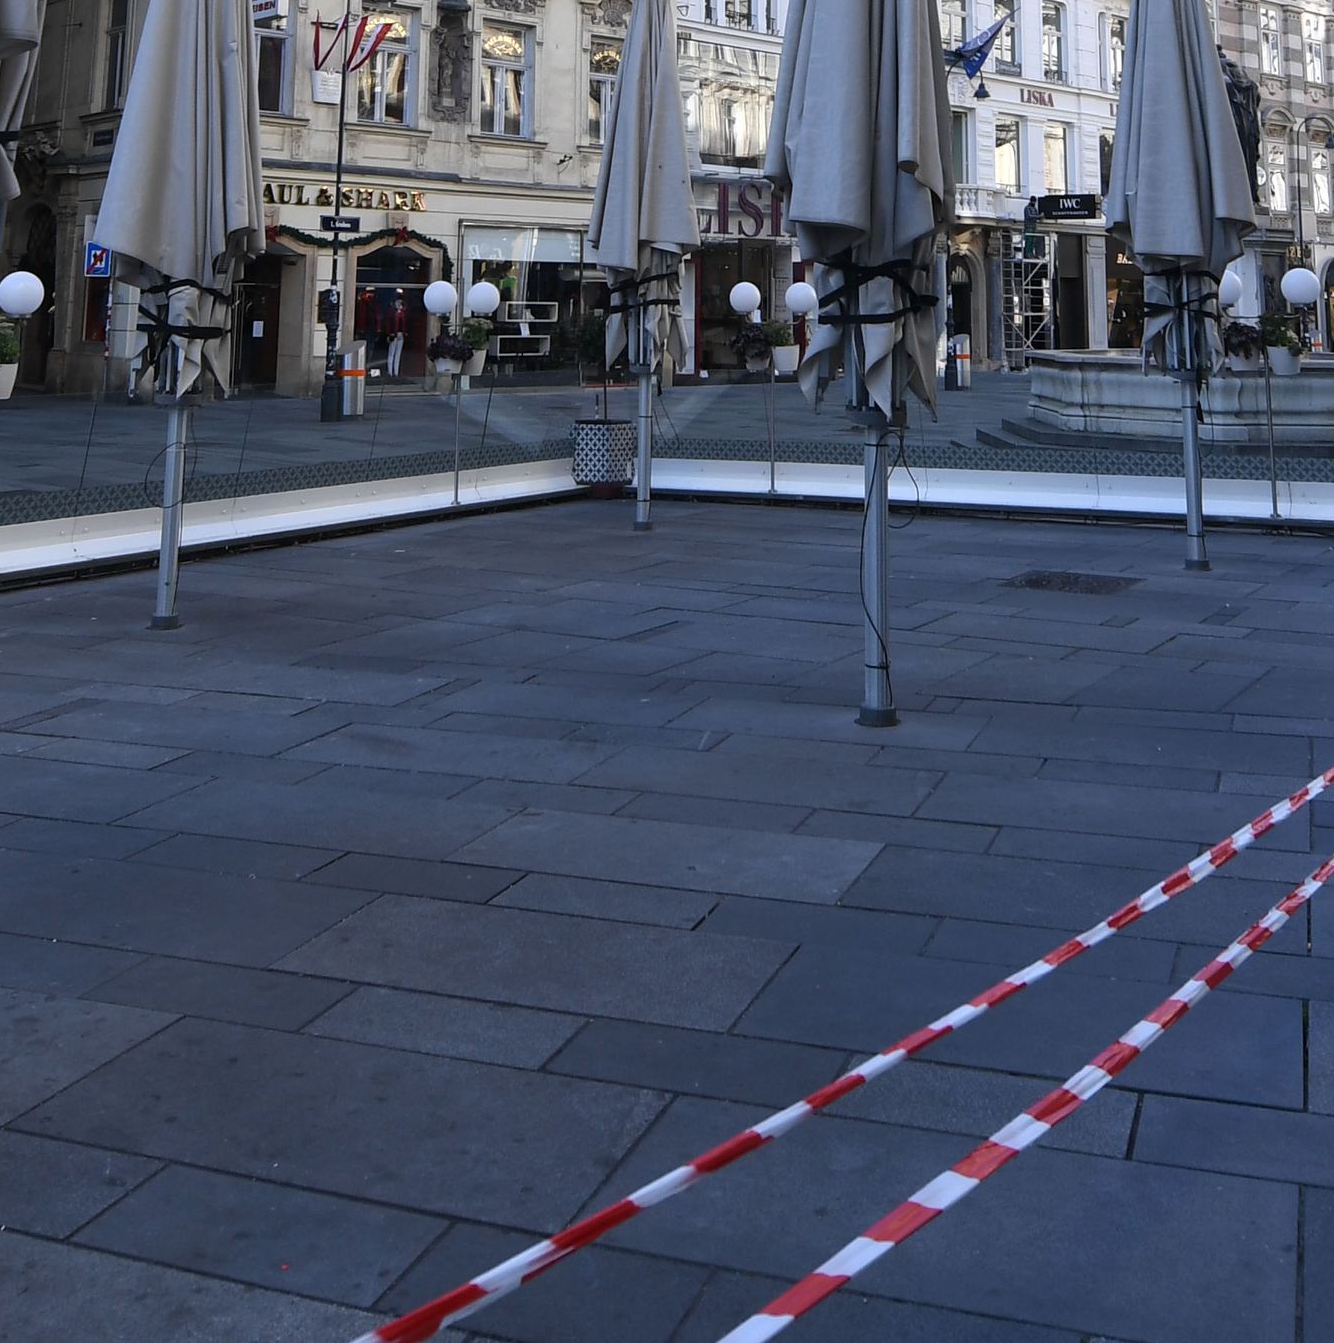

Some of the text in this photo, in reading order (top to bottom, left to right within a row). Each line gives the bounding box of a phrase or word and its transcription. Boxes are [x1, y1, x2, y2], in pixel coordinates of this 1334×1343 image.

[1020, 88, 1055, 107] LISKA
[340, 187, 427, 212] SHARK
[1059, 198, 1081, 209] IWC
